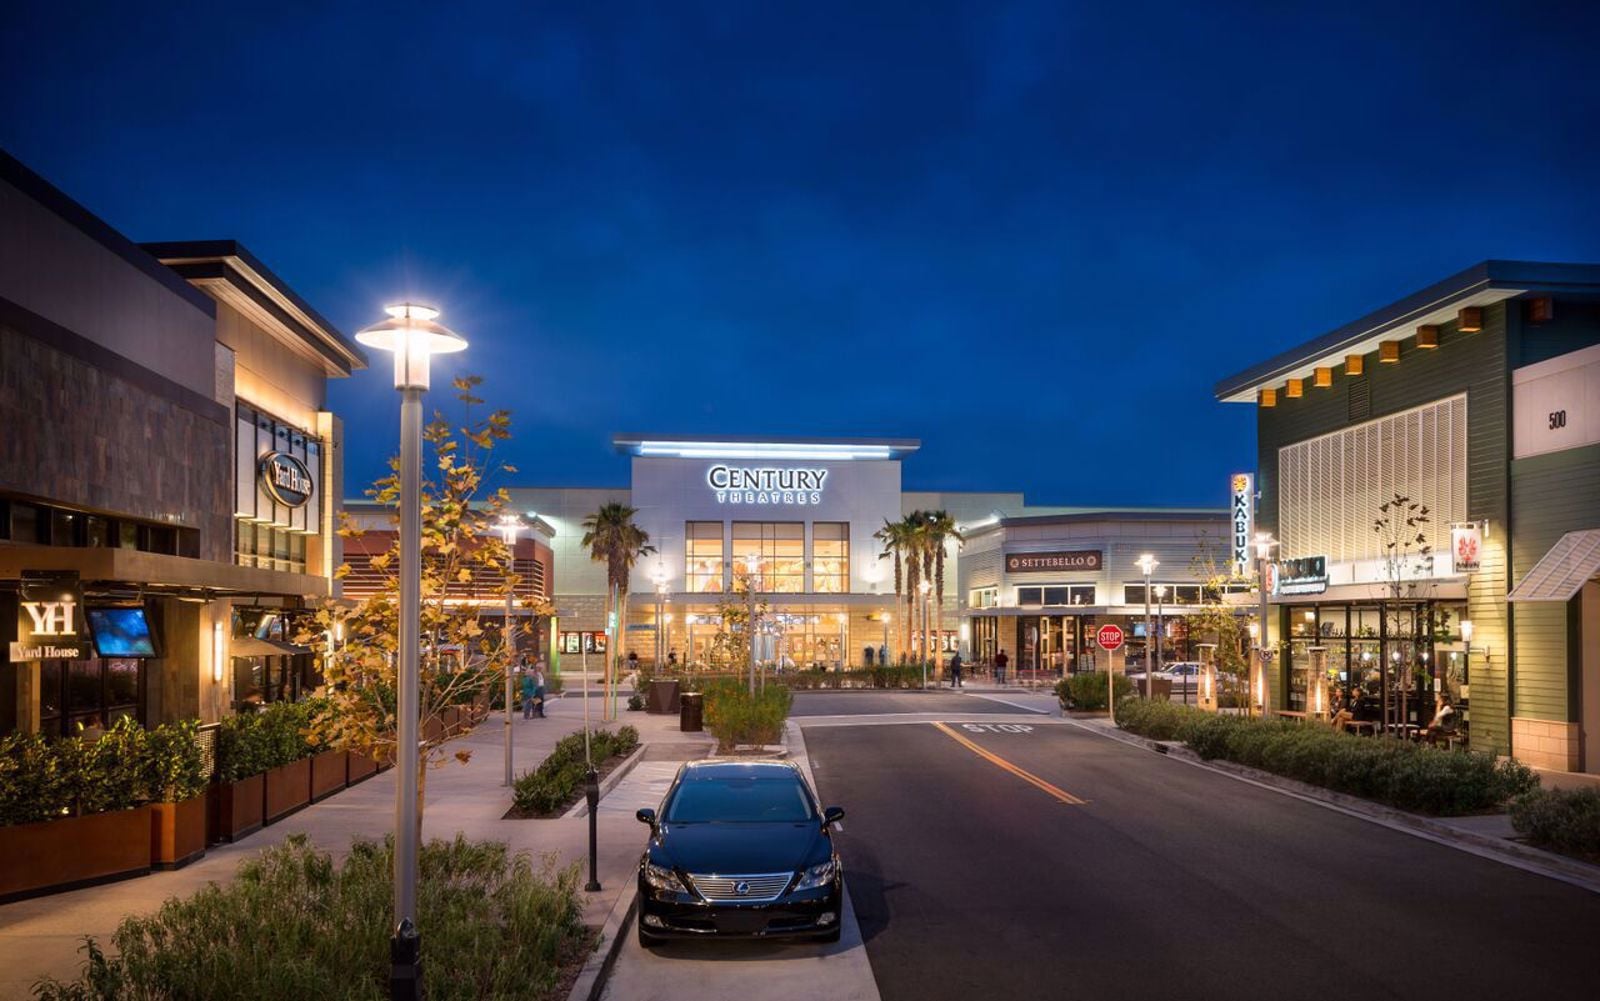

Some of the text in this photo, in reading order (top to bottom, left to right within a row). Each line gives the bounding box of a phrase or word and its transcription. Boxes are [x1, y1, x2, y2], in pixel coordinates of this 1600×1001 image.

[1549, 410, 1566, 430] 500
[273, 461, 311, 496] Yard House
[708, 465, 827, 490] CENTURY
[717, 492, 821, 503] THEATRES
[1234, 494, 1247, 575] KABUKI
[1021, 557, 1085, 567] SETTEBELLO
[20, 601, 77, 636] YH
[1100, 631, 1121, 642] STOP
[18, 645, 79, 659] Yard House
[961, 723, 1034, 733] STOP
